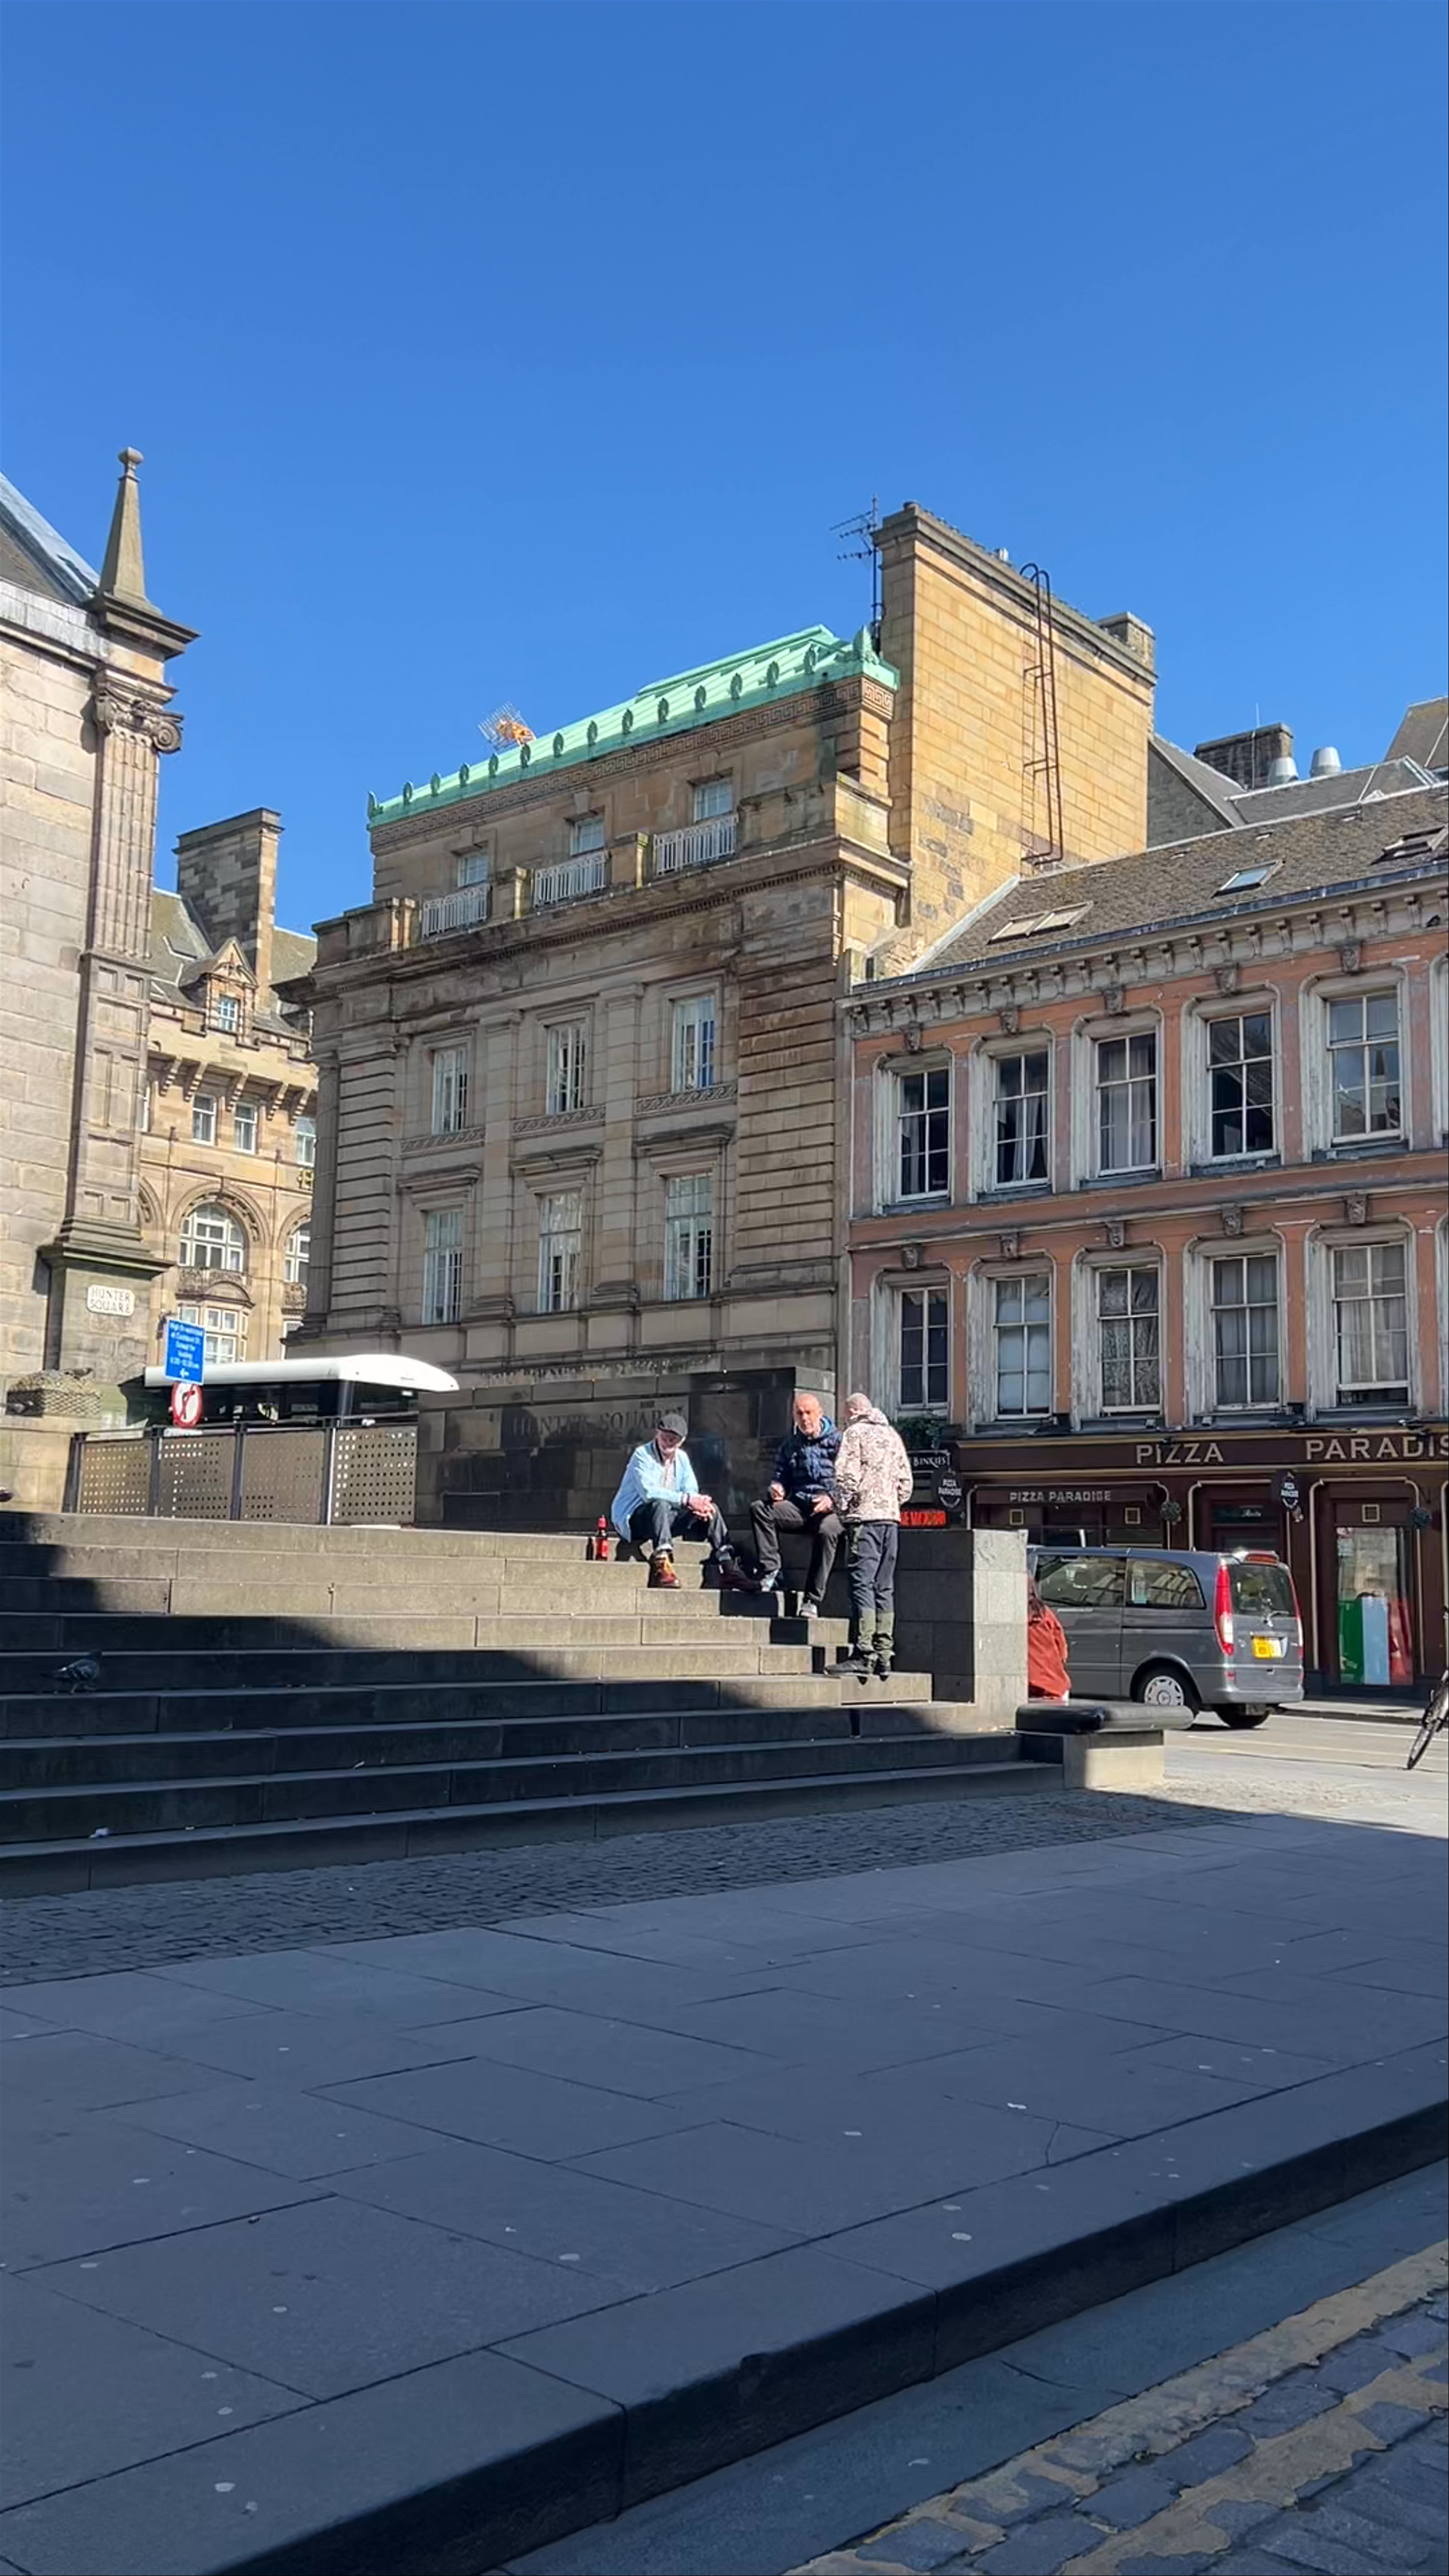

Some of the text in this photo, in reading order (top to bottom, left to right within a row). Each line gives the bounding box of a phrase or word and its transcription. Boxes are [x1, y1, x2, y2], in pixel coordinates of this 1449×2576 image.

[91, 1287, 130, 1301] HUNTER
[90, 1299, 130, 1313] SQUARE
[600, 1410, 677, 1433] SQUAR
[1136, 1443, 1224, 1464] PIZZA
[1009, 1491, 1111, 1502] PIZZA PARADISE
